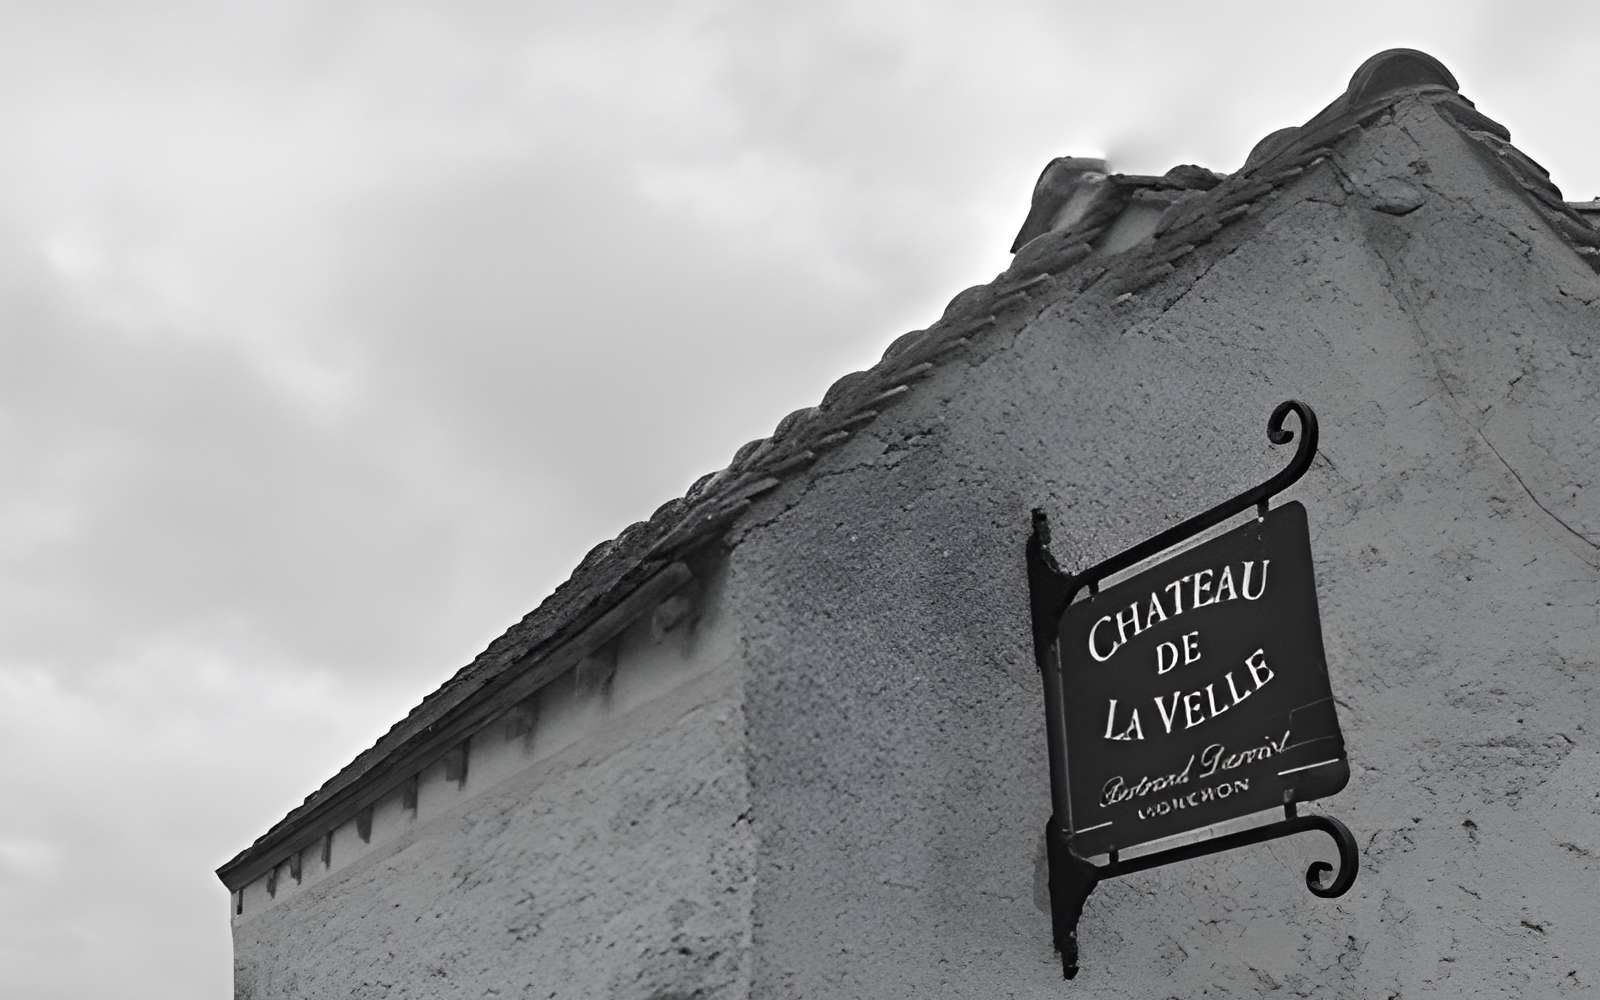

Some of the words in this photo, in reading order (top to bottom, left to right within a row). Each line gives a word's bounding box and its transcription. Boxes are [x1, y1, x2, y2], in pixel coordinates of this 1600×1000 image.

[1088, 560, 1270, 662] CHATEAU
[1155, 630, 1201, 675] DE
[1103, 698, 1145, 741] LA
[1153, 648, 1275, 734] VELLE
